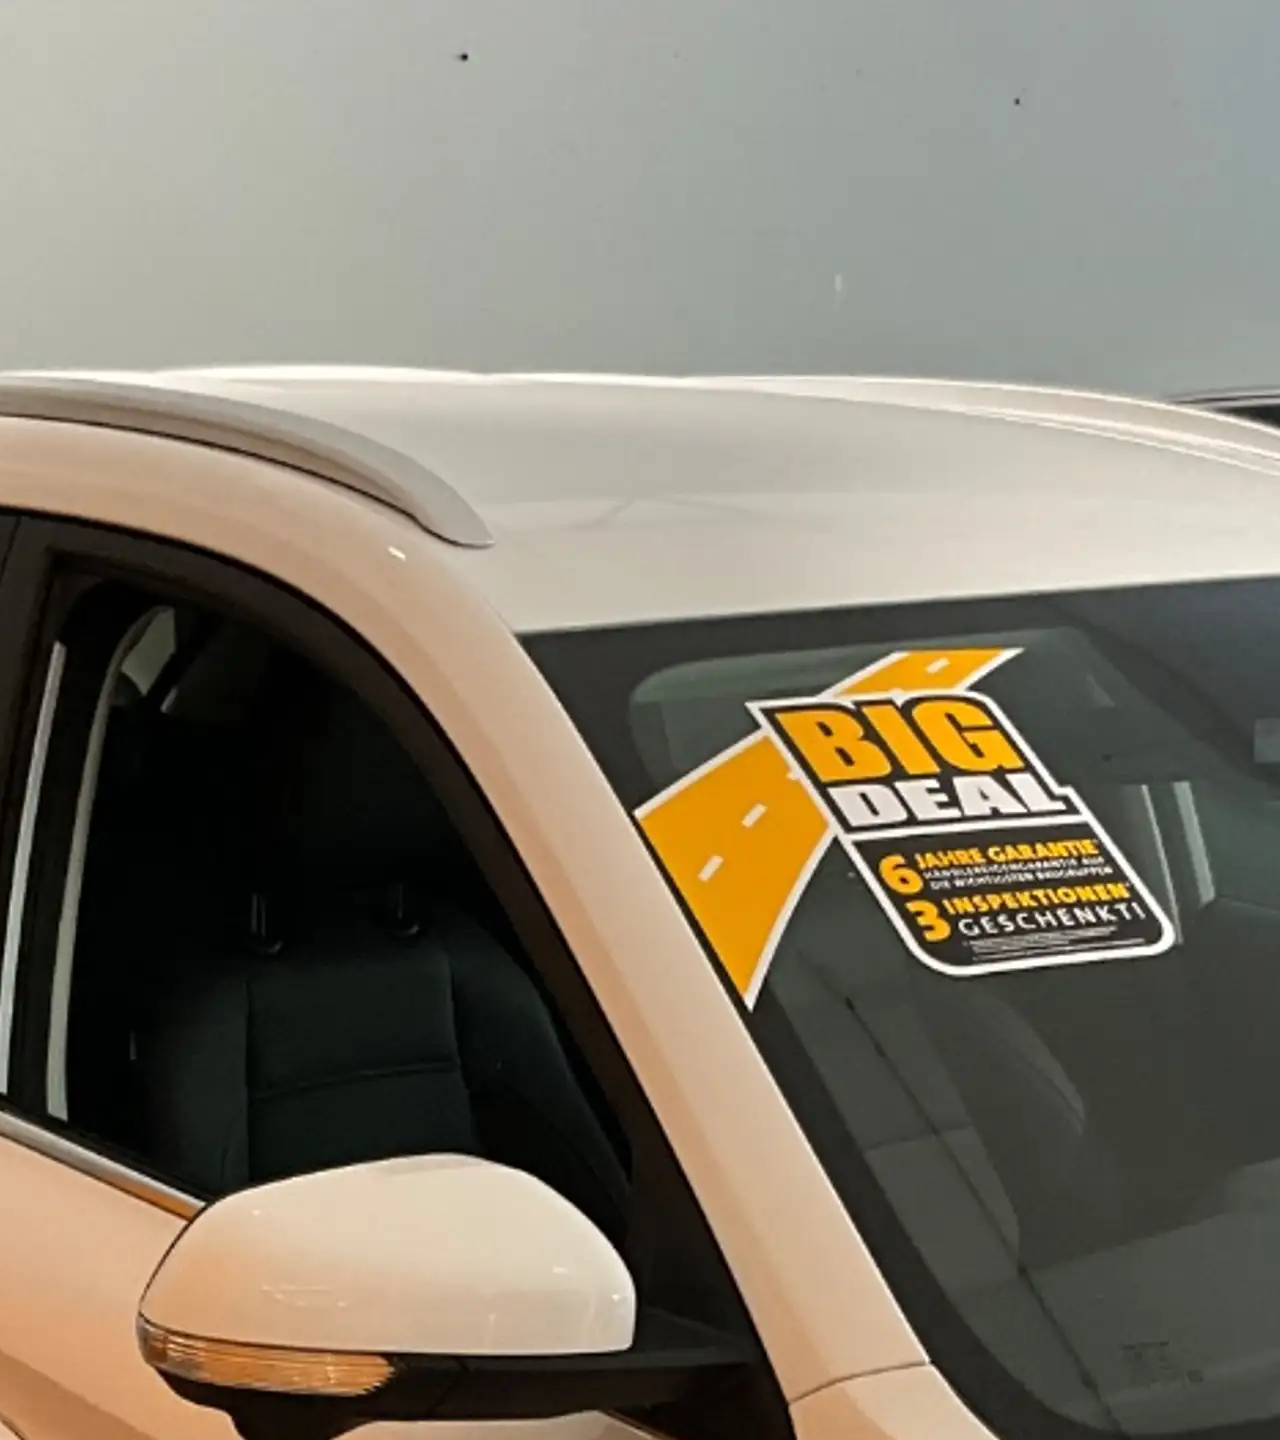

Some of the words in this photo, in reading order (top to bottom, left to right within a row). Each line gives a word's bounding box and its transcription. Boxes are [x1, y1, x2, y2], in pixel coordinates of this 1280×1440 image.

[775, 698, 1025, 783] BIG
[825, 773, 1067, 828] DEAL
[878, 854, 924, 896] 6
[914, 847, 985, 870] JAHRE
[904, 899, 952, 943] 3
[957, 902, 1147, 937] GESCHENKT!
